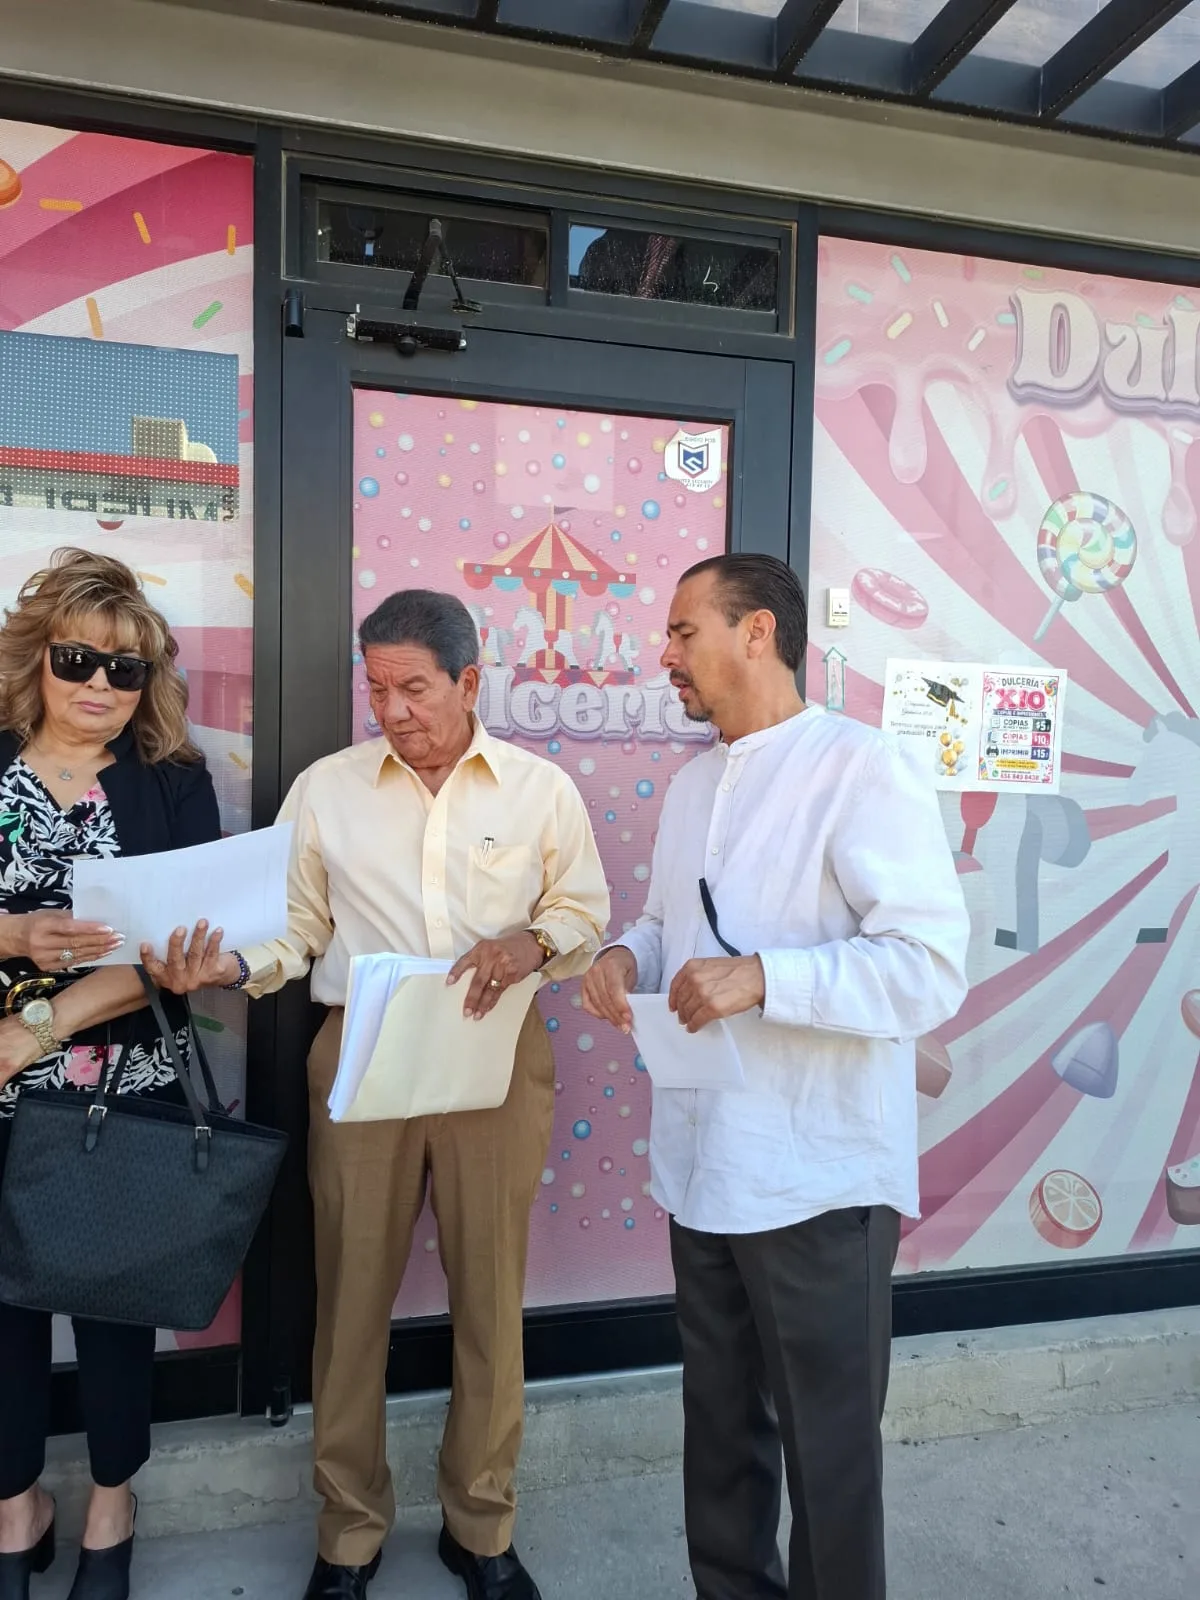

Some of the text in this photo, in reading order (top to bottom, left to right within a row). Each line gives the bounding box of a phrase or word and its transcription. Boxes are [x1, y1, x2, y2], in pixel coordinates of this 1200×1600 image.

[1001, 677, 1040, 688] DULCERÍA
[355, 664, 714, 742] lcería
[1003, 719, 1029, 727] COPIAS
[1002, 732, 1029, 741] COPIAS
